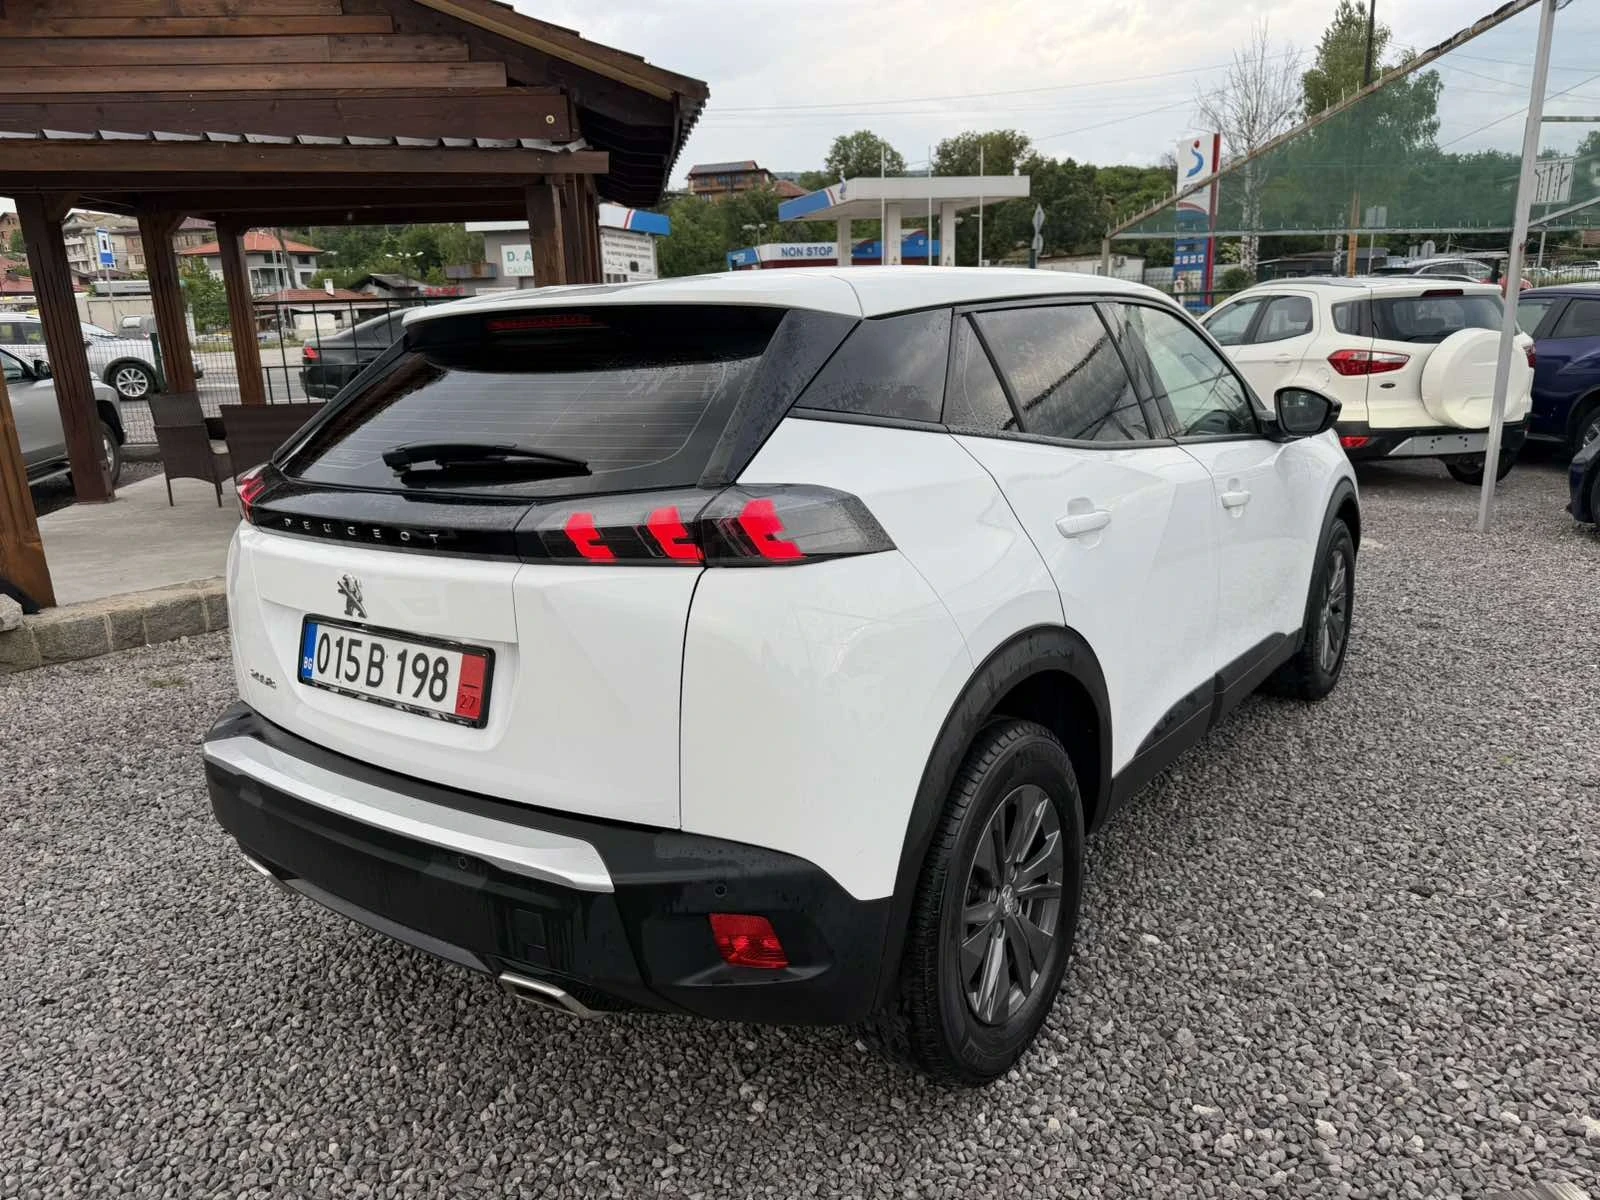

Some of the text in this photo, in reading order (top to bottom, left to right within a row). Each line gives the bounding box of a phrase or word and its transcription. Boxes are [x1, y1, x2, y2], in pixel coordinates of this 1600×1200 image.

[781, 246, 833, 257] NON STOP
[284, 518, 439, 544] PEUGEOT
[303, 656, 312, 670] BG
[460, 694, 477, 710] 27
